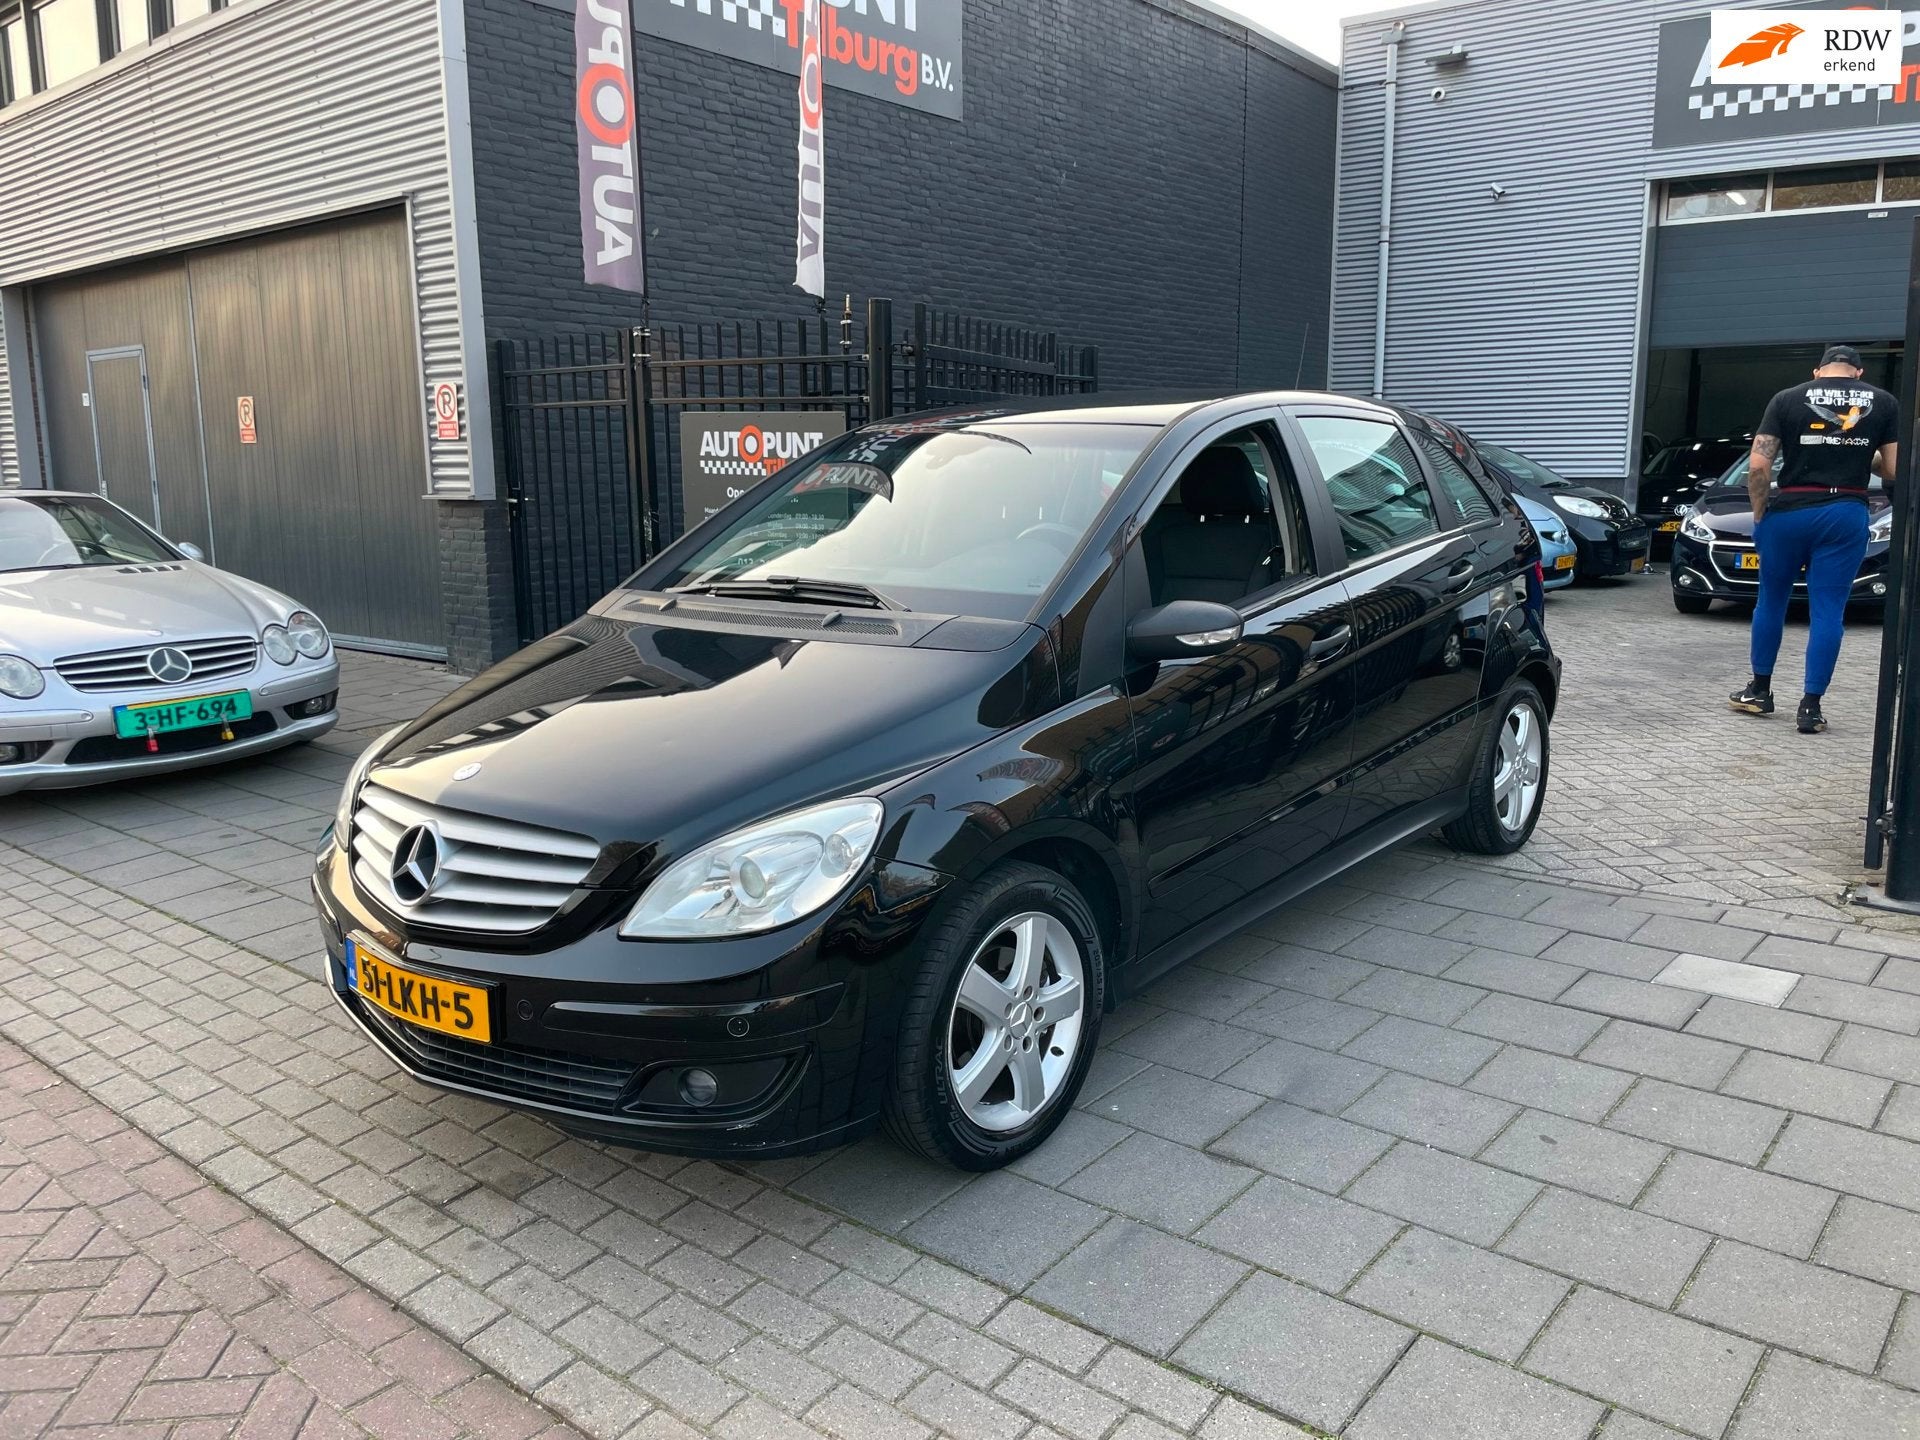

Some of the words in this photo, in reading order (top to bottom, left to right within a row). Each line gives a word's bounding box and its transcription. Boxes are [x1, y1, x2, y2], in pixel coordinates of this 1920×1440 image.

[779, 0, 919, 96] Tlburg
[921, 52, 955, 93] B.V.
[1805, 388, 1822, 397] AIR
[1823, 388, 1849, 398] WILL
[1809, 396, 1833, 405] YOU
[360, 955, 474, 1030] 51-LKH-5
